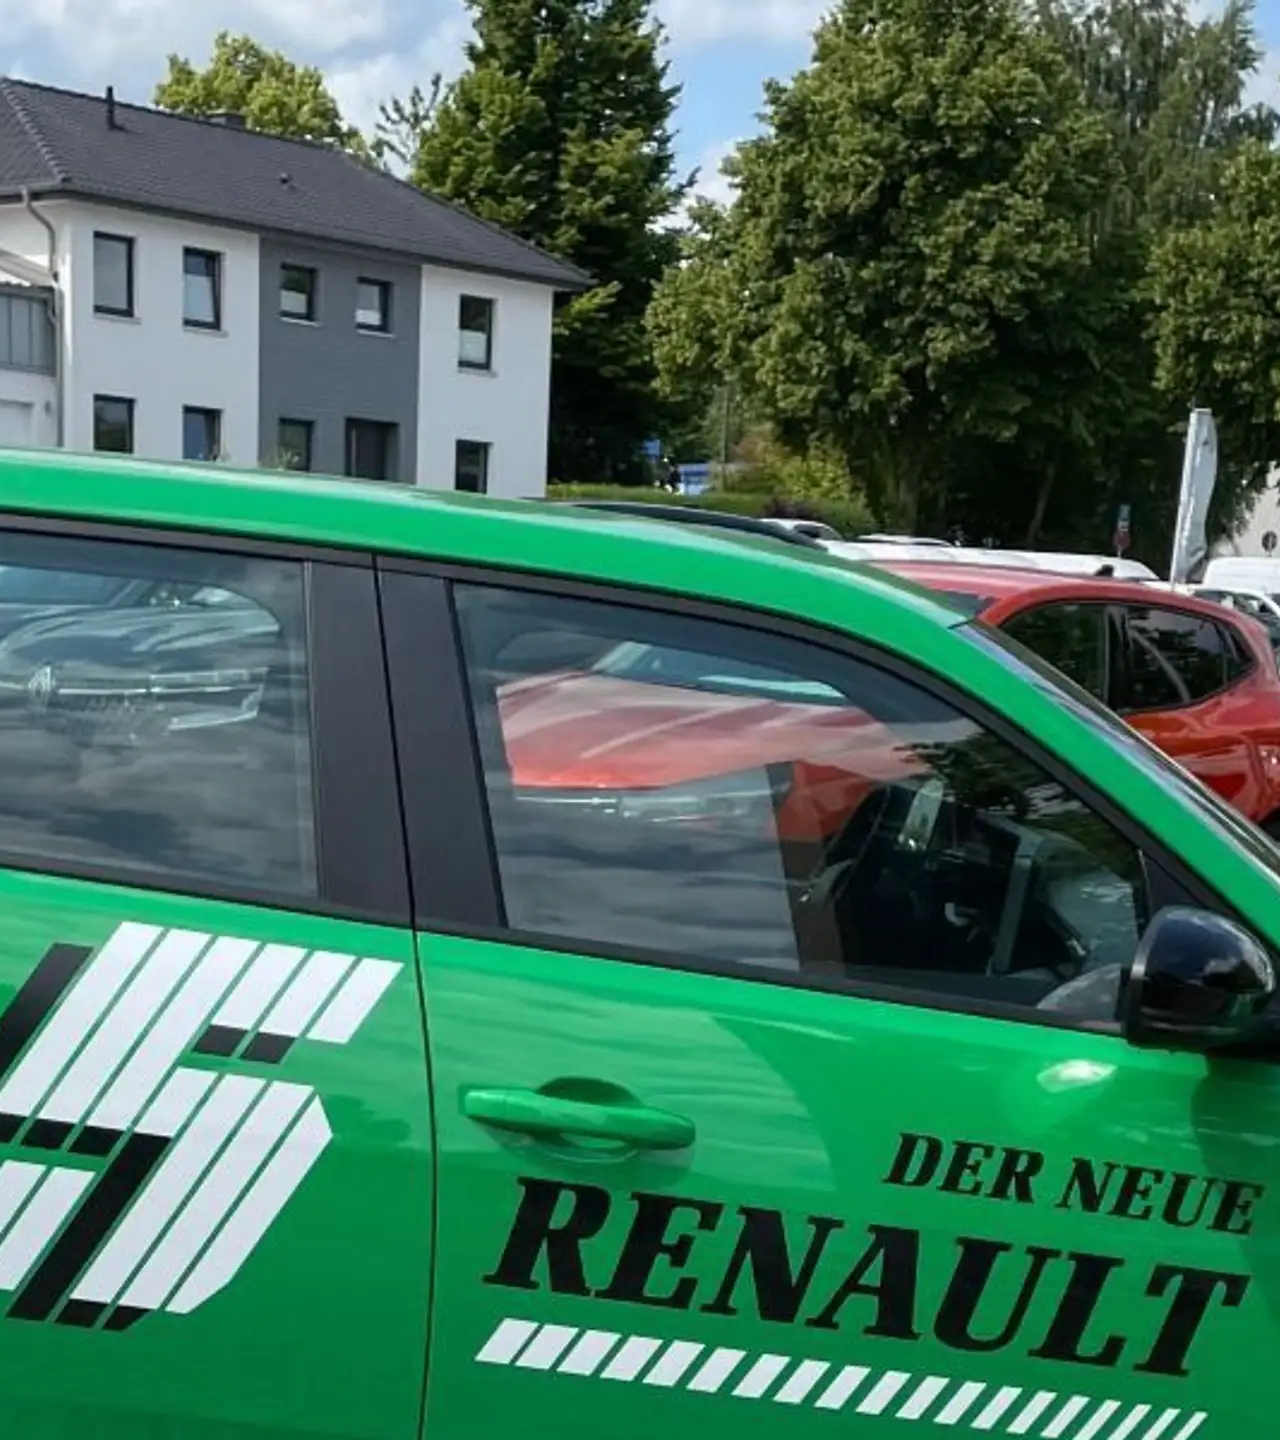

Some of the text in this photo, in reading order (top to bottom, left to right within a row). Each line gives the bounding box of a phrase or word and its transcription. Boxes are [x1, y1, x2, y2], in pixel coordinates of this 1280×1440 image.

[883, 1132, 1266, 1236] DER NEUE
[481, 1175, 1252, 1378] RENAULT
